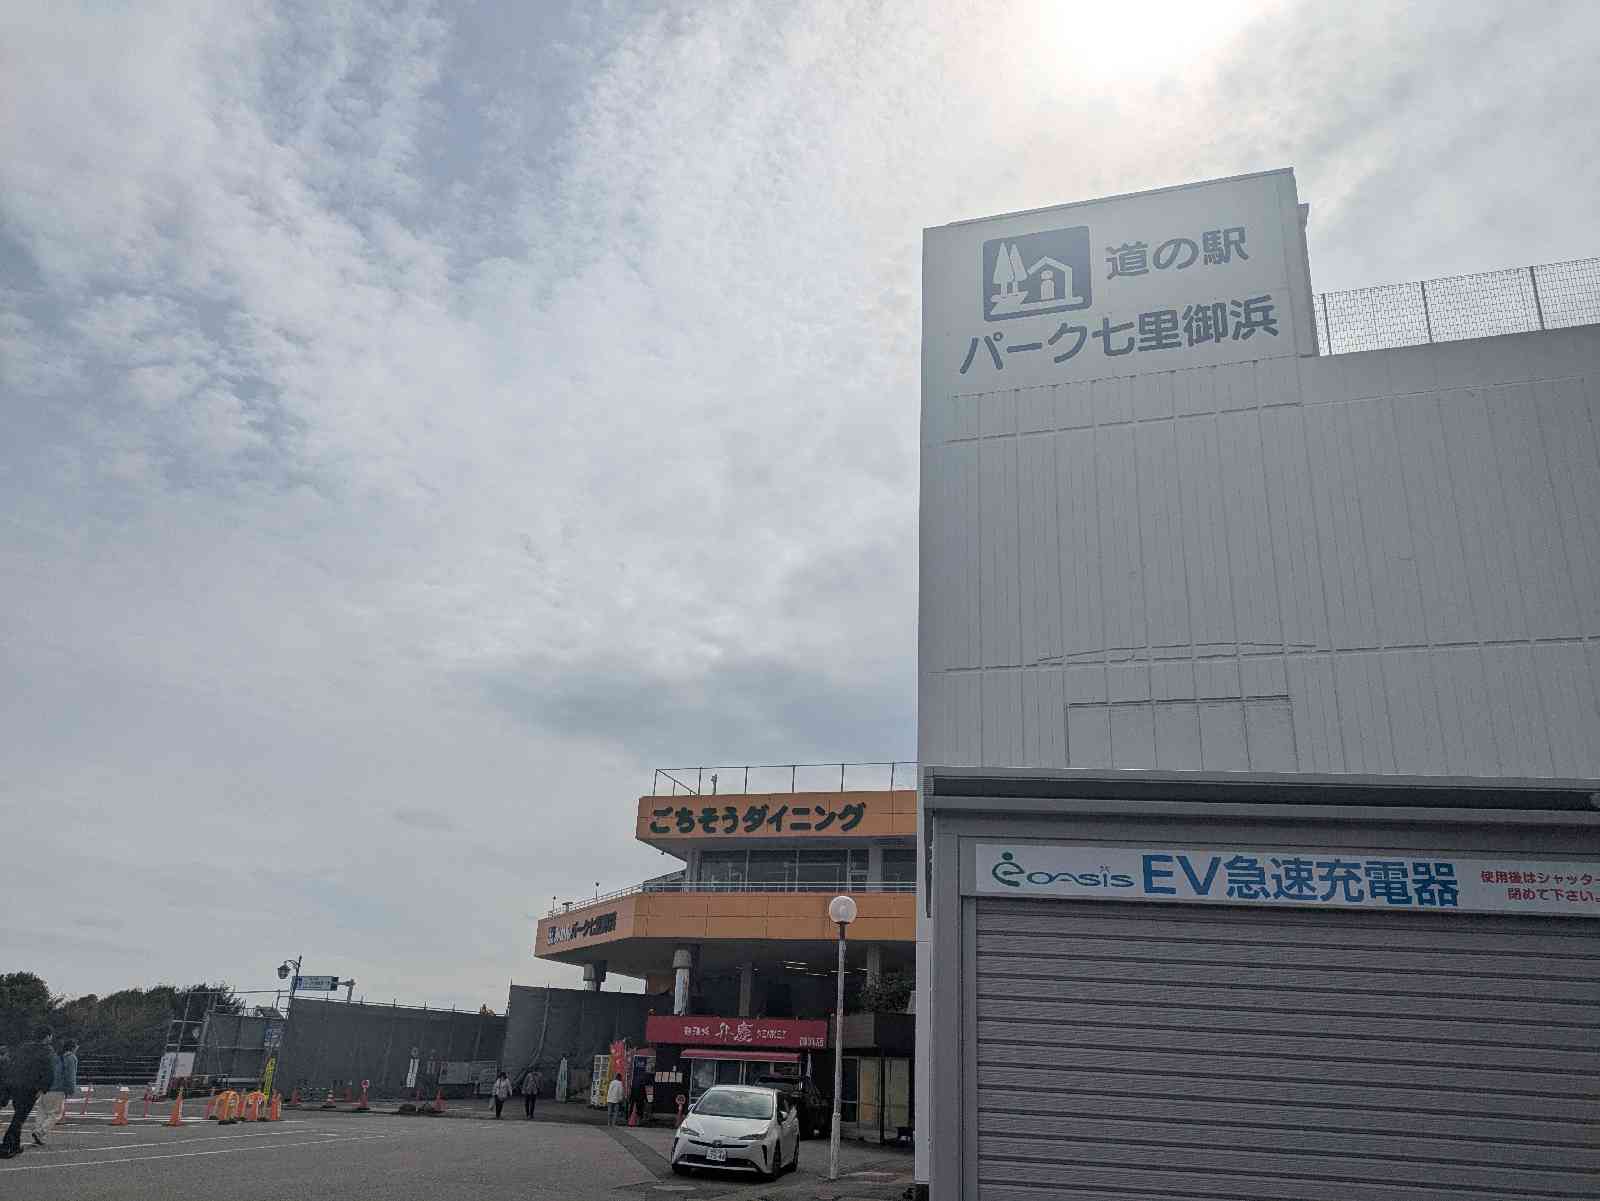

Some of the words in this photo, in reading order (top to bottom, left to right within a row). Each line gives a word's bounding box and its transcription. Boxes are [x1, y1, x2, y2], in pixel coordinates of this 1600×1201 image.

[1105, 226, 1249, 280] 道の駅
[959, 294, 1279, 375] パーク七里御浜
[650, 801, 867, 834] ごちそうダイニング
[1141, 854, 1459, 907] EV急速充電器
